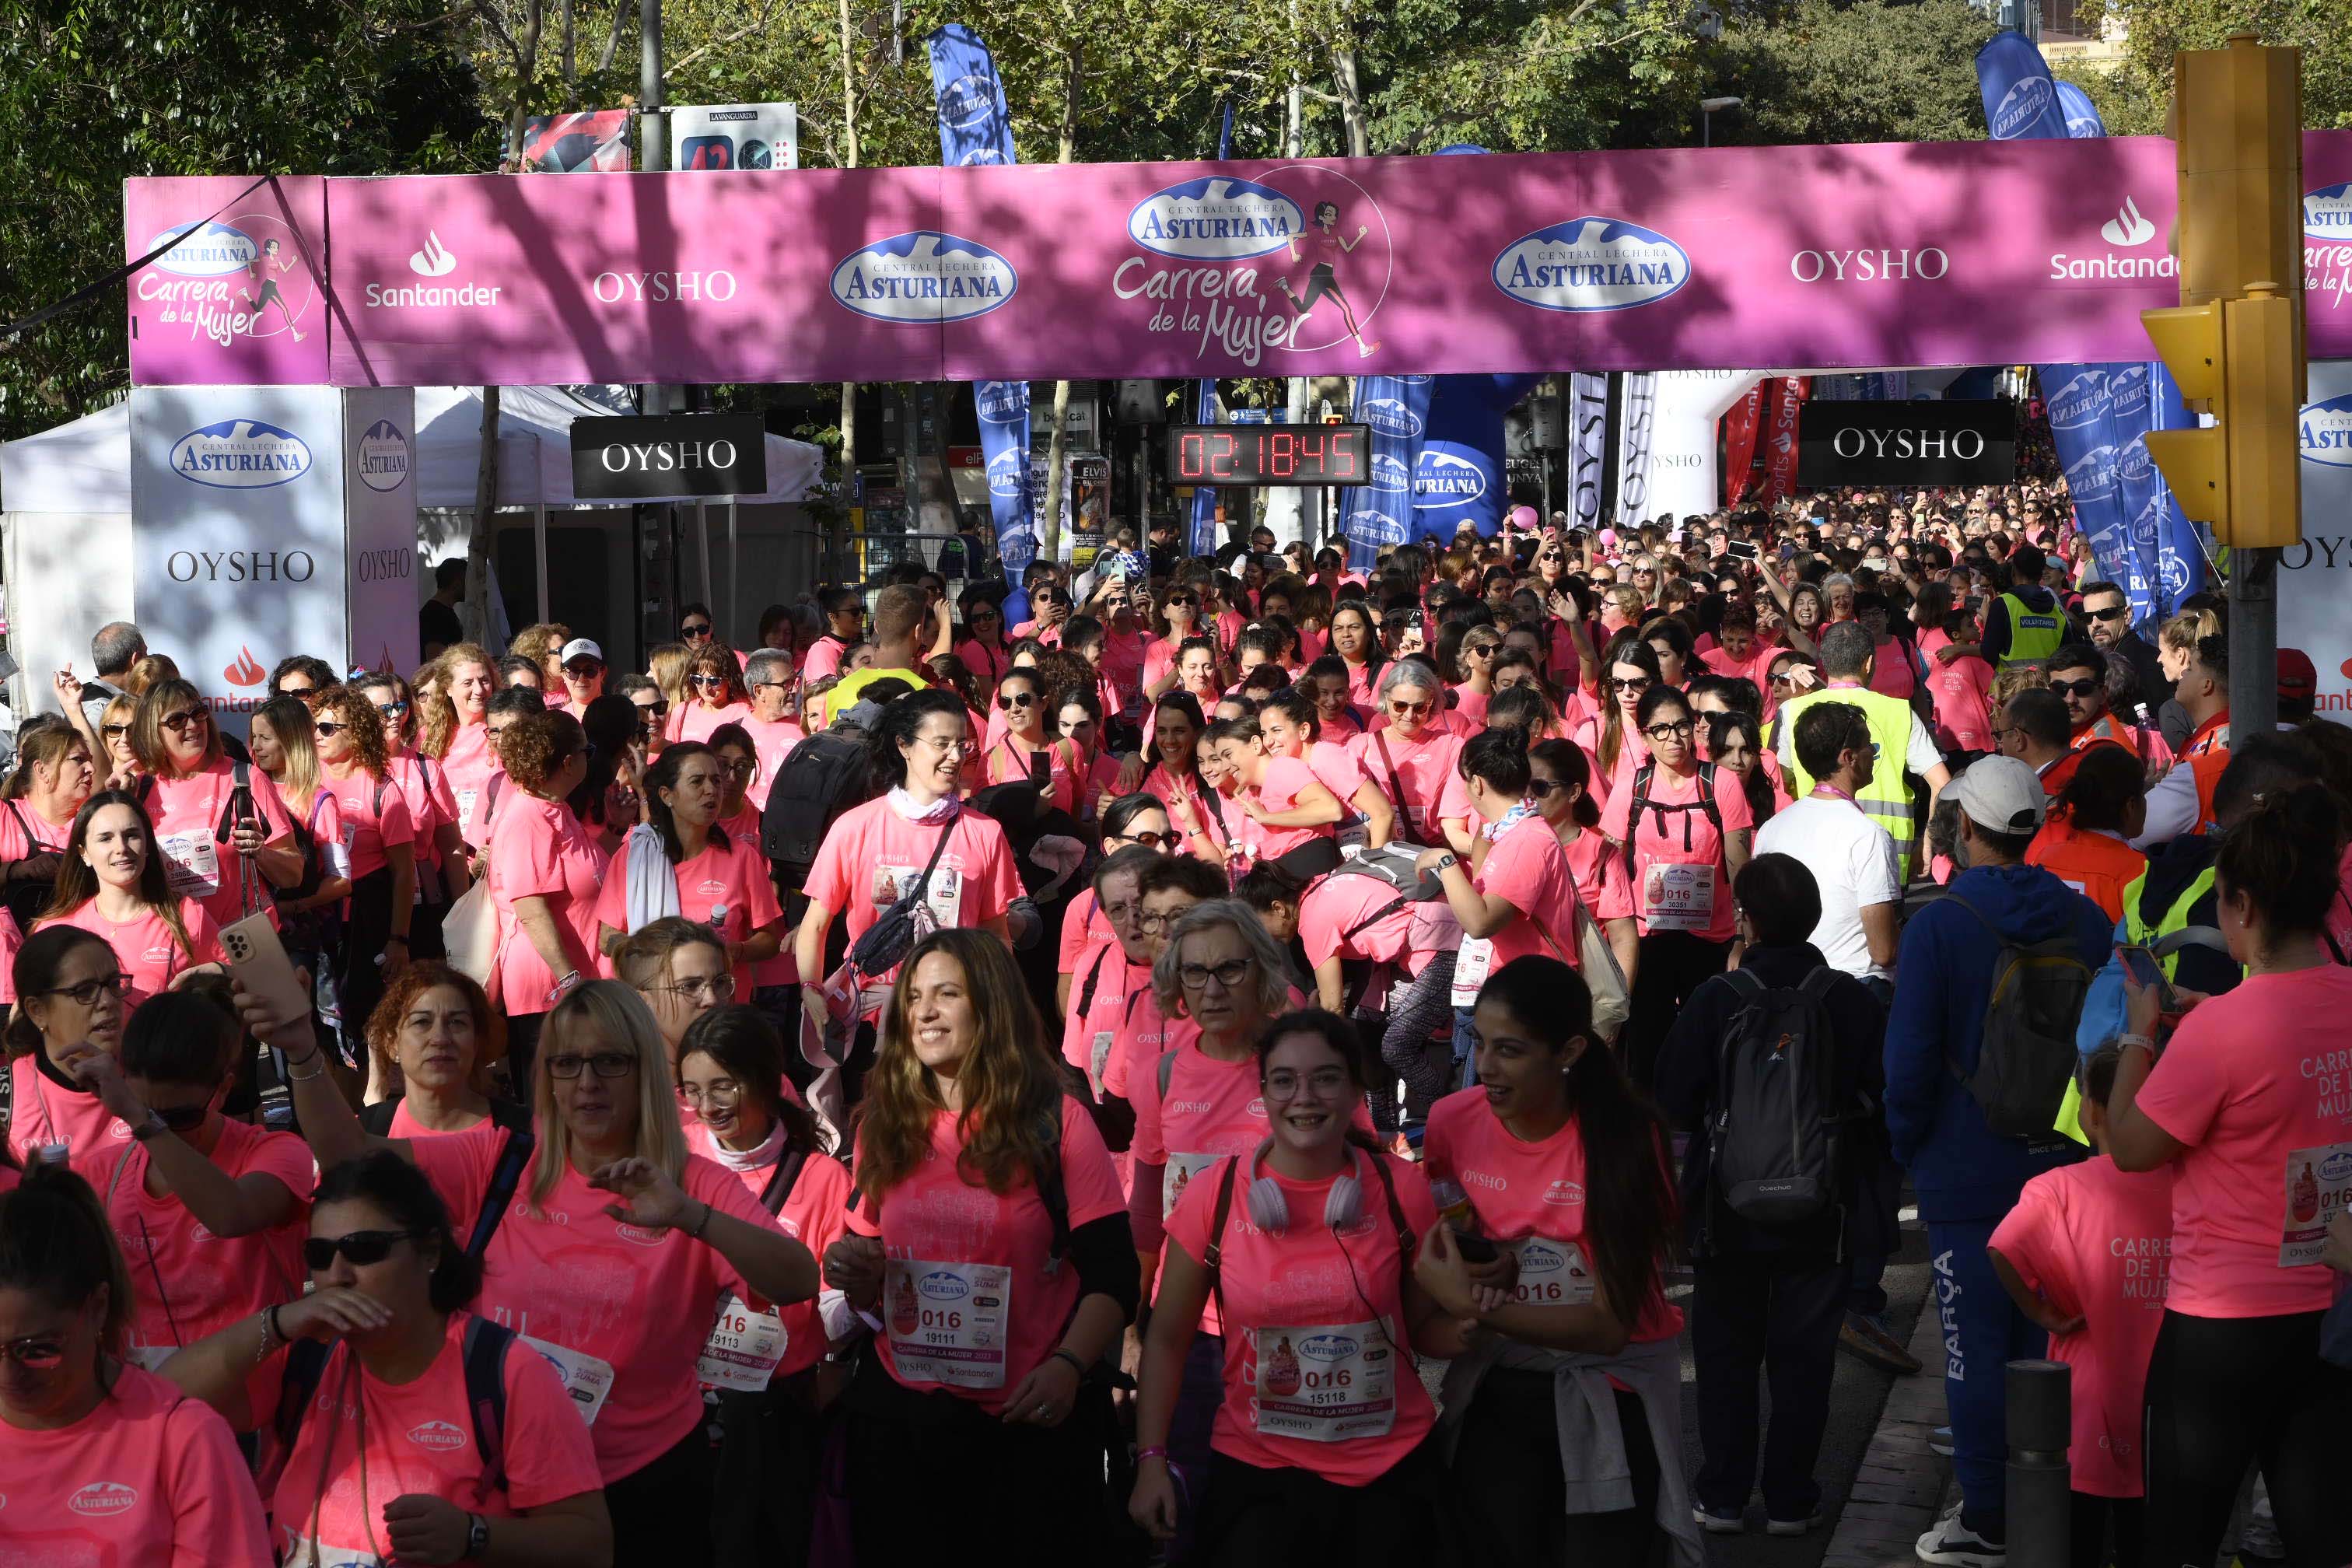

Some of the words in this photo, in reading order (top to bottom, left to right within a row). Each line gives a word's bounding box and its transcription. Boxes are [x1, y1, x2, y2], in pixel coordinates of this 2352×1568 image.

[1168, 205, 1224, 215] CENTRAL
[1229, 205, 1286, 214] LECHERA
[1141, 208, 1290, 240] ASTURIANA
[156, 240, 249, 263] ASTURIANA
[1538, 250, 1591, 261] CENTRAL
[1605, 249, 1668, 259] LECHERA
[873, 263, 930, 272] CENTRAL
[937, 262, 996, 272] LECHERA
[1507, 254, 1675, 288] ASTURIANA
[1790, 247, 1949, 282] OYSHO
[2050, 253, 2179, 280] Santand
[137, 273, 229, 302] Carrera
[593, 269, 737, 303] OYSHO
[844, 266, 1003, 300] ASTURIANA
[1111, 256, 1258, 299] Carrera
[366, 282, 501, 307] Santander
[160, 300, 177, 323] de
[180, 299, 194, 323] la
[190, 299, 264, 348] Mujer
[1148, 302, 1175, 332] de
[1181, 300, 1202, 332] la
[1196, 297, 1313, 367] Mujer
[1575, 371, 1608, 523] OYSH
[1623, 371, 1653, 511] OYSH
[1833, 428, 1984, 460] OYSHO
[180, 445, 302, 471] ASTURIANA
[361, 448, 406, 474] ASTURIANA
[602, 439, 737, 472] OYSHO
[1181, 433, 1354, 477] 02:18:45
[1655, 453, 1702, 468] YSHO
[1083, 467, 1107, 477] ELVIS
[1415, 478, 1478, 494] URIANA
[167, 551, 314, 583] OYSHO
[359, 547, 411, 582] OYSHO
[2021, 617, 2056, 628] VOLUNTARIS
[1667, 889, 1691, 900] 016
[2301, 1048, 2352, 1079] CARR
[2319, 1073, 2341, 1096] DE
[1173, 1101, 1211, 1113] OYSHO
[1462, 1169, 1507, 1192] OYSHO
[2110, 1237, 2172, 1257] CARRE
[2126, 1258, 2149, 1277] DE
[922, 1280, 965, 1294] ASTURIANA
[1517, 1283, 1562, 1301] 016
[2123, 1278, 2169, 1298] MUJE
[716, 1313, 747, 1333] 16
[922, 1310, 962, 1328] 016
[1934, 1249, 1965, 1381] BARÇA
[925, 1332, 956, 1345] 19111
[1300, 1343, 1354, 1356] ASTURIANA
[948, 1349, 972, 1358] MUJER
[954, 1367, 996, 1377] Santander
[1305, 1369, 1352, 1388] 016
[1310, 1391, 1346, 1405] 15118
[411, 1430, 462, 1444] ASTURIANA
[73, 1495, 133, 1509] ASTURIANA
